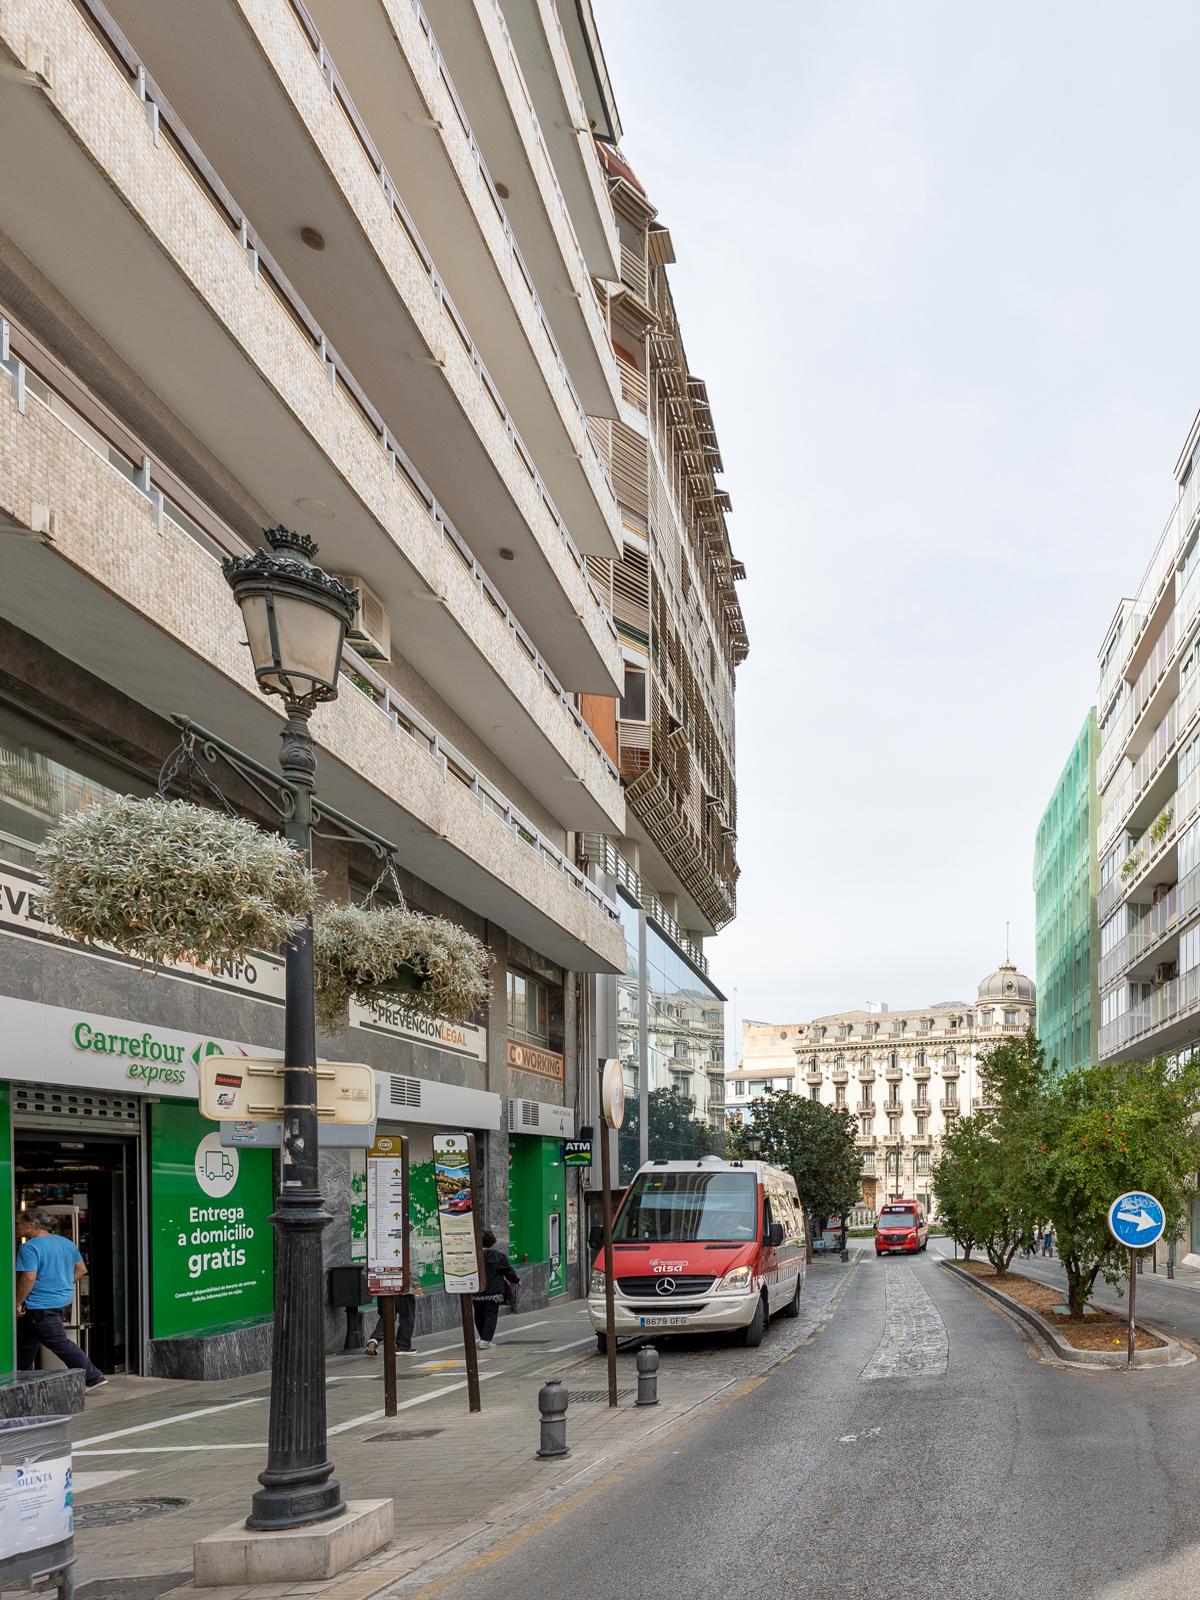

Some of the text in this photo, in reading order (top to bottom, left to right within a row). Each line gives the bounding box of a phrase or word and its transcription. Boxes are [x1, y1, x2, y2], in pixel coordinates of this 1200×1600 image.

[74, 1022, 186, 1063] Carrefour
[510, 1045, 560, 1075] COWORKING
[129, 1063, 186, 1086] express
[565, 1142, 591, 1151] ATM
[189, 1206, 245, 1224] Entrega
[177, 1223, 255, 1246] a domicilio
[188, 1243, 247, 1278] gratis
[653, 1265, 683, 1273] alsa
[646, 1318, 668, 1326] 8679
